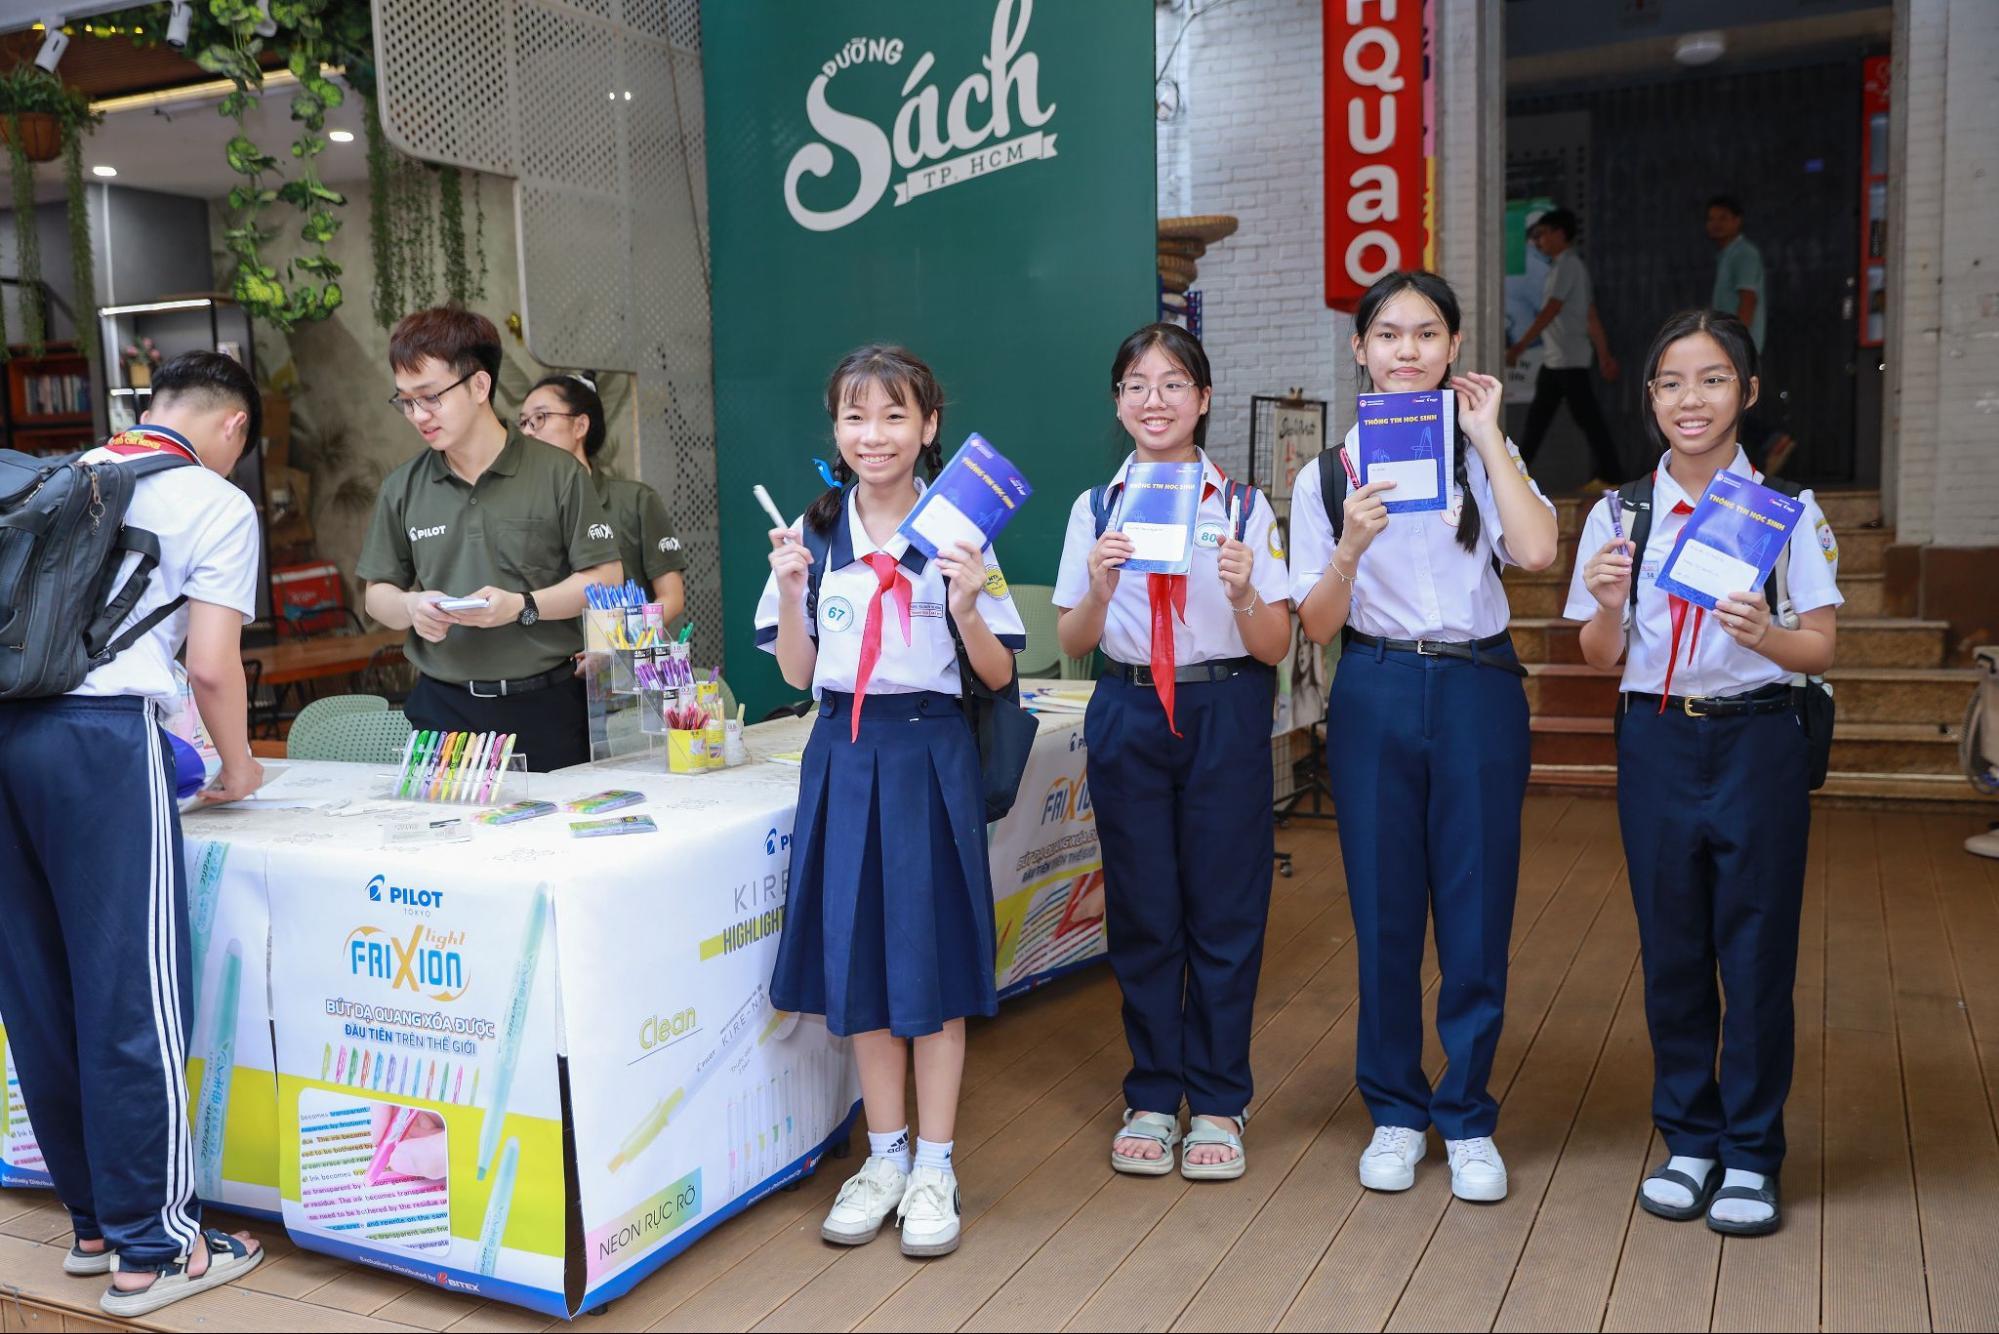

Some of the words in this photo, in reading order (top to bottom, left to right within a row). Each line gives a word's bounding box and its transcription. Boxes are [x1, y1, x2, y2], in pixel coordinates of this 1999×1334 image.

[784, 0, 1057, 232] Sách
[923, 168, 959, 189] TP.
[970, 143, 1025, 175] HCM
[416, 525, 447, 540] PILOT
[589, 523, 613, 540] FRIX
[1201, 531, 1217, 543] 80
[828, 606, 846, 621] 67
[390, 886, 443, 908] PILOT
[735, 868, 789, 914] KIRE
[404, 908, 431, 918] TOKYO
[425, 928, 465, 950] light
[723, 905, 785, 955] HIGHLIGHT
[326, 997, 351, 1016] BÚT
[354, 1004, 373, 1023] DẠ
[374, 1006, 422, 1028] QUANG
[422, 1011, 453, 1031] XÓA
[368, 1026, 393, 1042] TIÊN
[395, 1030, 424, 1047] TRÊN
[639, 1006, 696, 1050] Clean
[599, 1219, 641, 1261] NEON
[448, 1279, 481, 1293] BITEX
